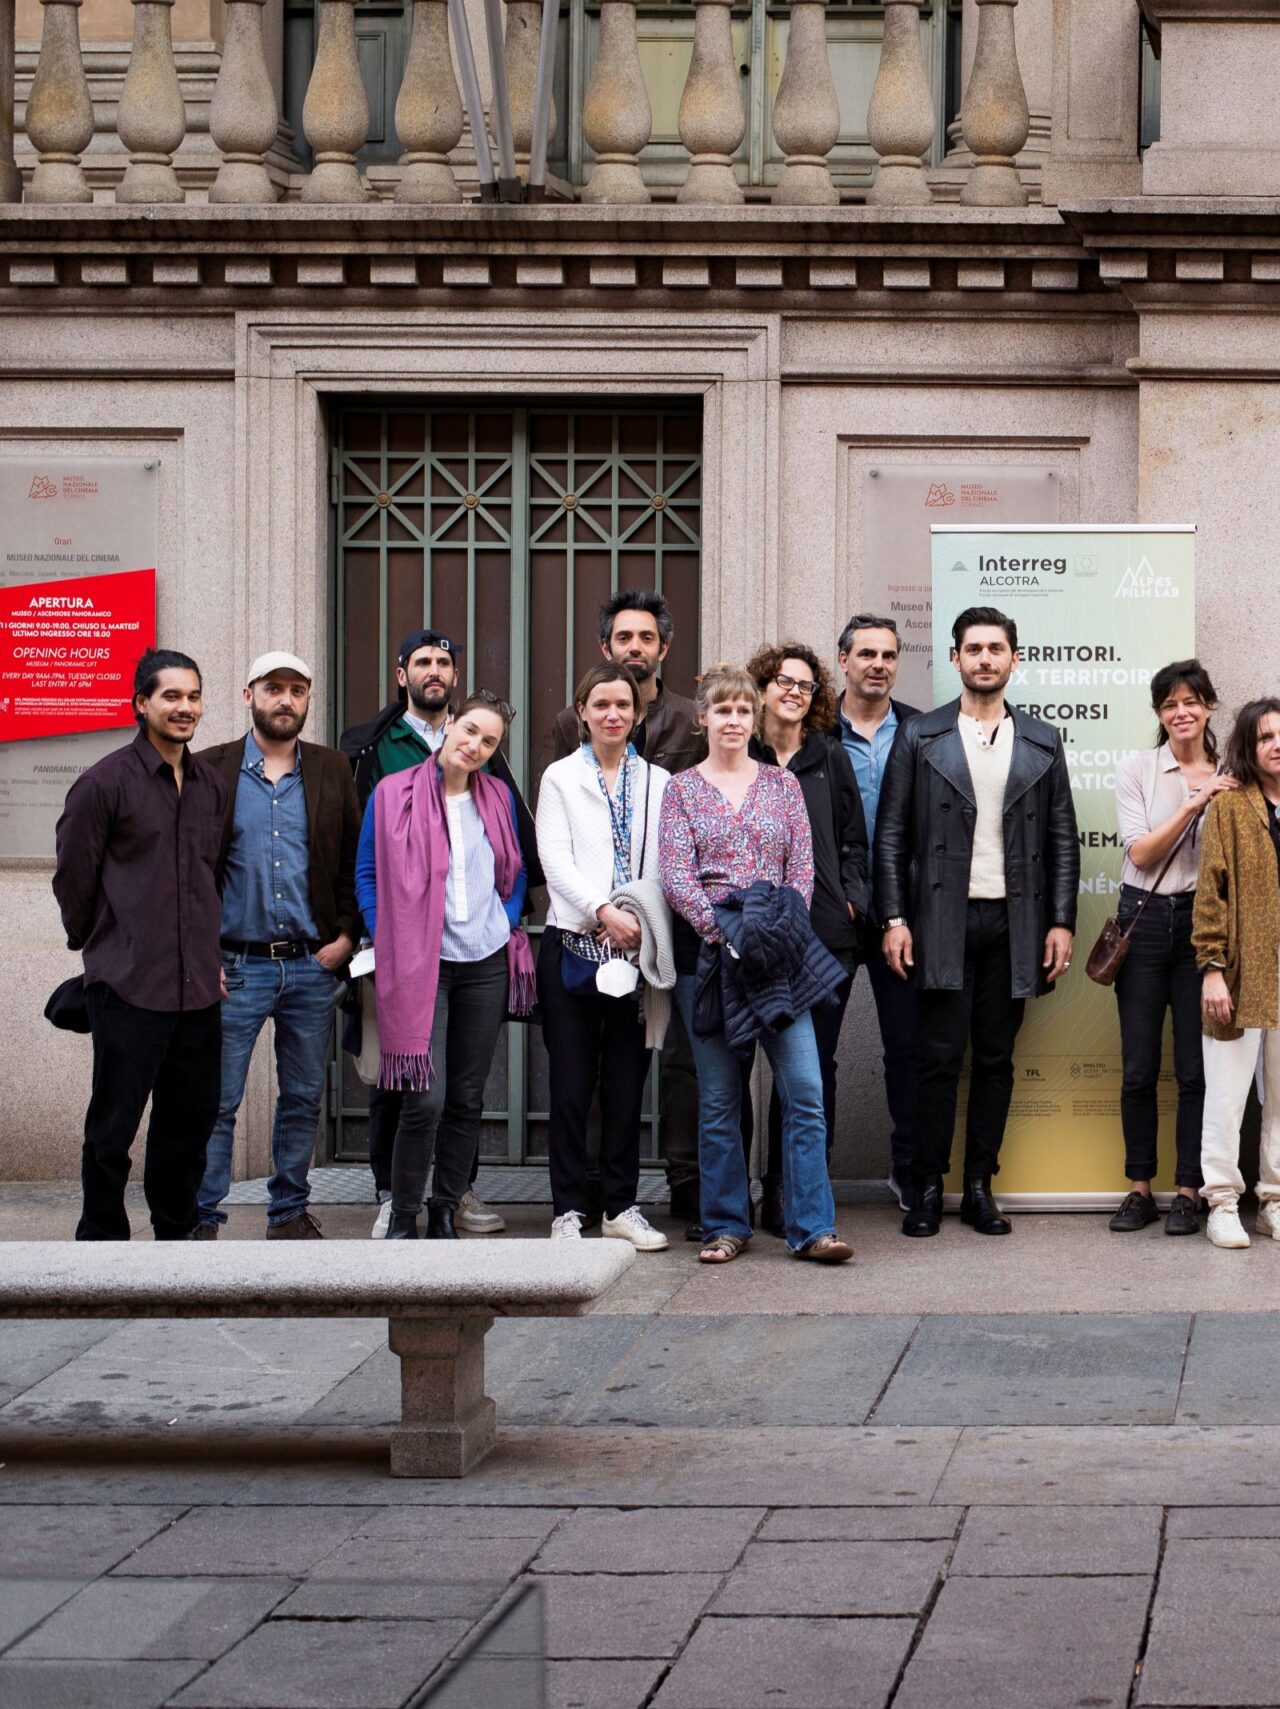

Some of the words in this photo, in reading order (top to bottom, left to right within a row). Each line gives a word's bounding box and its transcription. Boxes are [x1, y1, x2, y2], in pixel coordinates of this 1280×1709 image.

[54, 537, 72, 545] Orari
[6, 553, 32, 562] MUSEO
[34, 553, 75, 562] NAZIONALE
[76, 553, 89, 562] DEL
[90, 553, 120, 562] CINEMA
[979, 555, 1067, 575] Interreg
[980, 576, 1040, 586] ALCOTRA
[1122, 588, 1151, 598] FILM
[1155, 588, 1180, 598] LAB
[29, 597, 94, 608] APERTURA
[891, 601, 923, 611] Museo
[12, 630, 39, 638] ULTIMO
[40, 630, 75, 638] INGRESSO
[77, 630, 91, 638] ORE
[93, 630, 111, 638] 18.00
[13, 647, 67, 659] OPENING
[70, 647, 110, 659] HOURS
[1018, 646, 1122, 662] ERRITORI.
[2, 672, 21, 680] EVERY
[22, 672, 34, 680] DAY
[68, 672, 96, 680] TUESDAY
[96, 672, 121, 680] CLOSED
[1036, 669, 1158, 686] TERRITOIR
[33, 765, 78, 773] PANORAMIC
[1077, 832, 1125, 847] NEM
[1025, 1069, 1041, 1077] TFL
